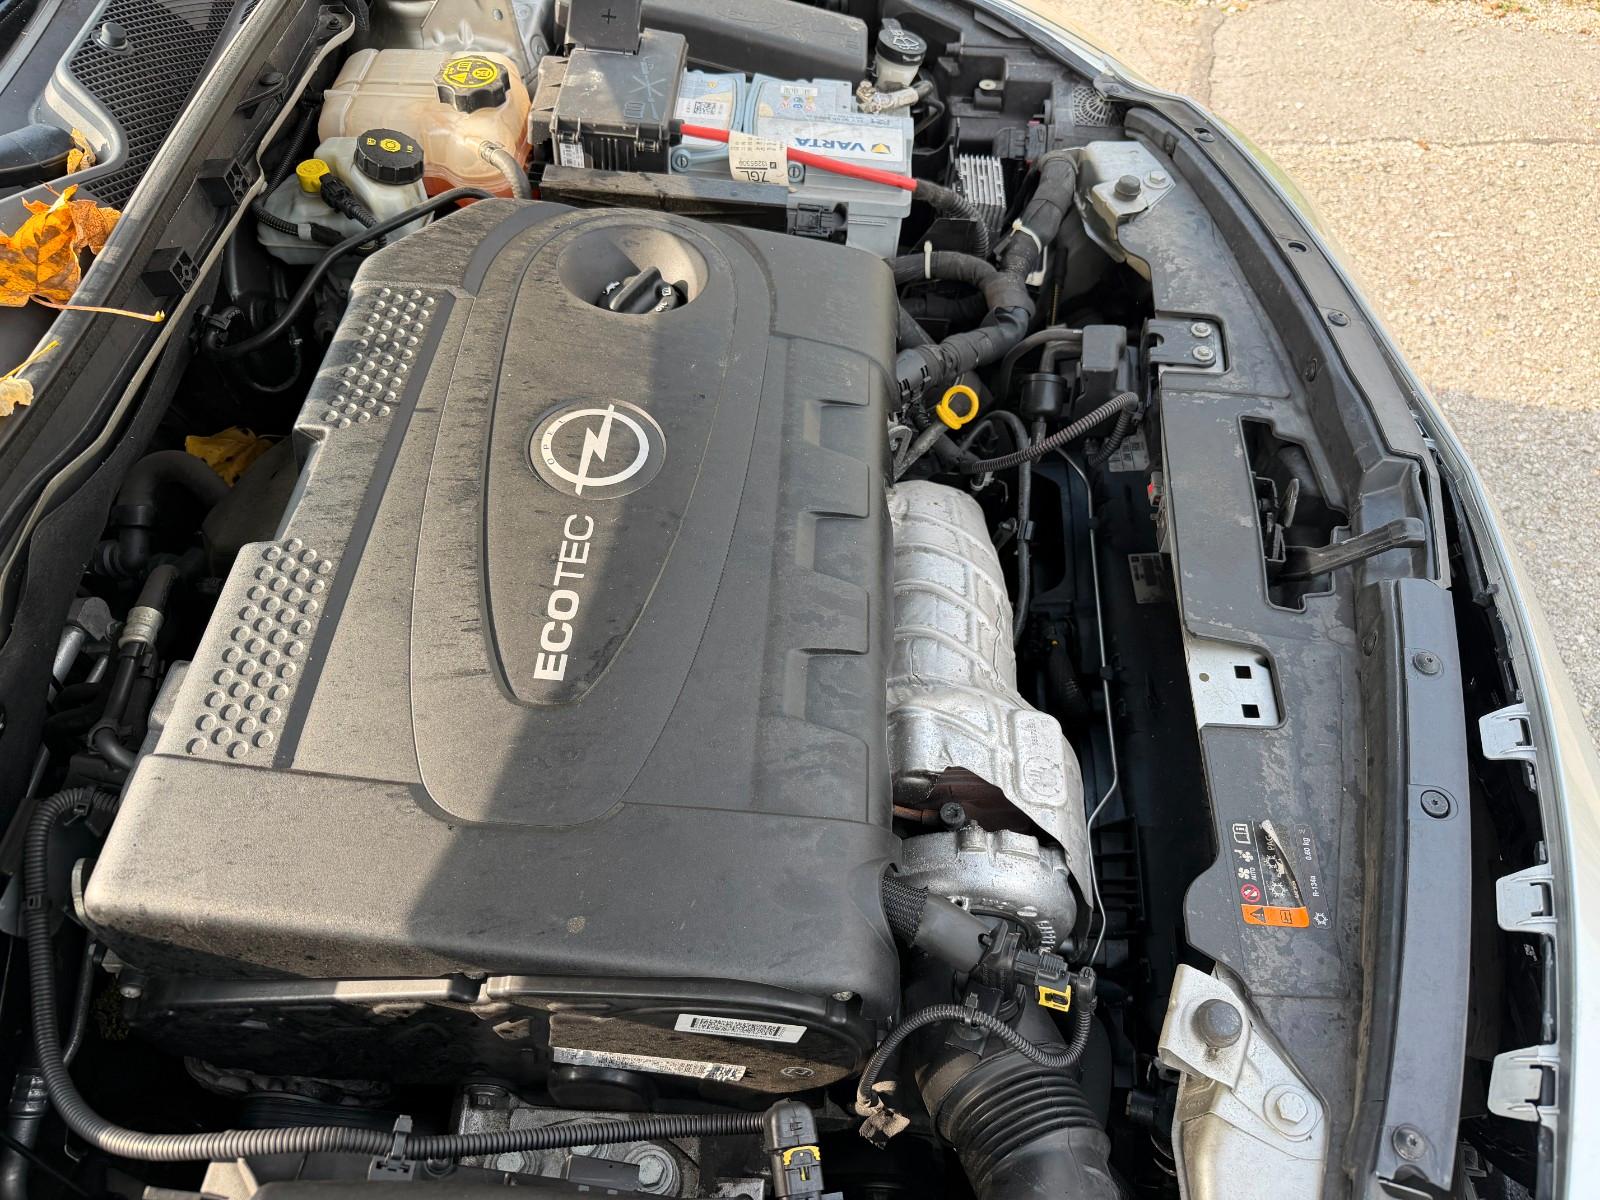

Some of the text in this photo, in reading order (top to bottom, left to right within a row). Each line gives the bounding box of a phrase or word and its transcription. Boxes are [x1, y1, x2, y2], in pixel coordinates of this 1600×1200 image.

[795, 137, 865, 151] VARTA
[543, 419, 566, 466] OPEL
[533, 514, 594, 681] ECOTEC
[1302, 837, 1311, 847] kg
[1311, 875, 1320, 897] R-134a
